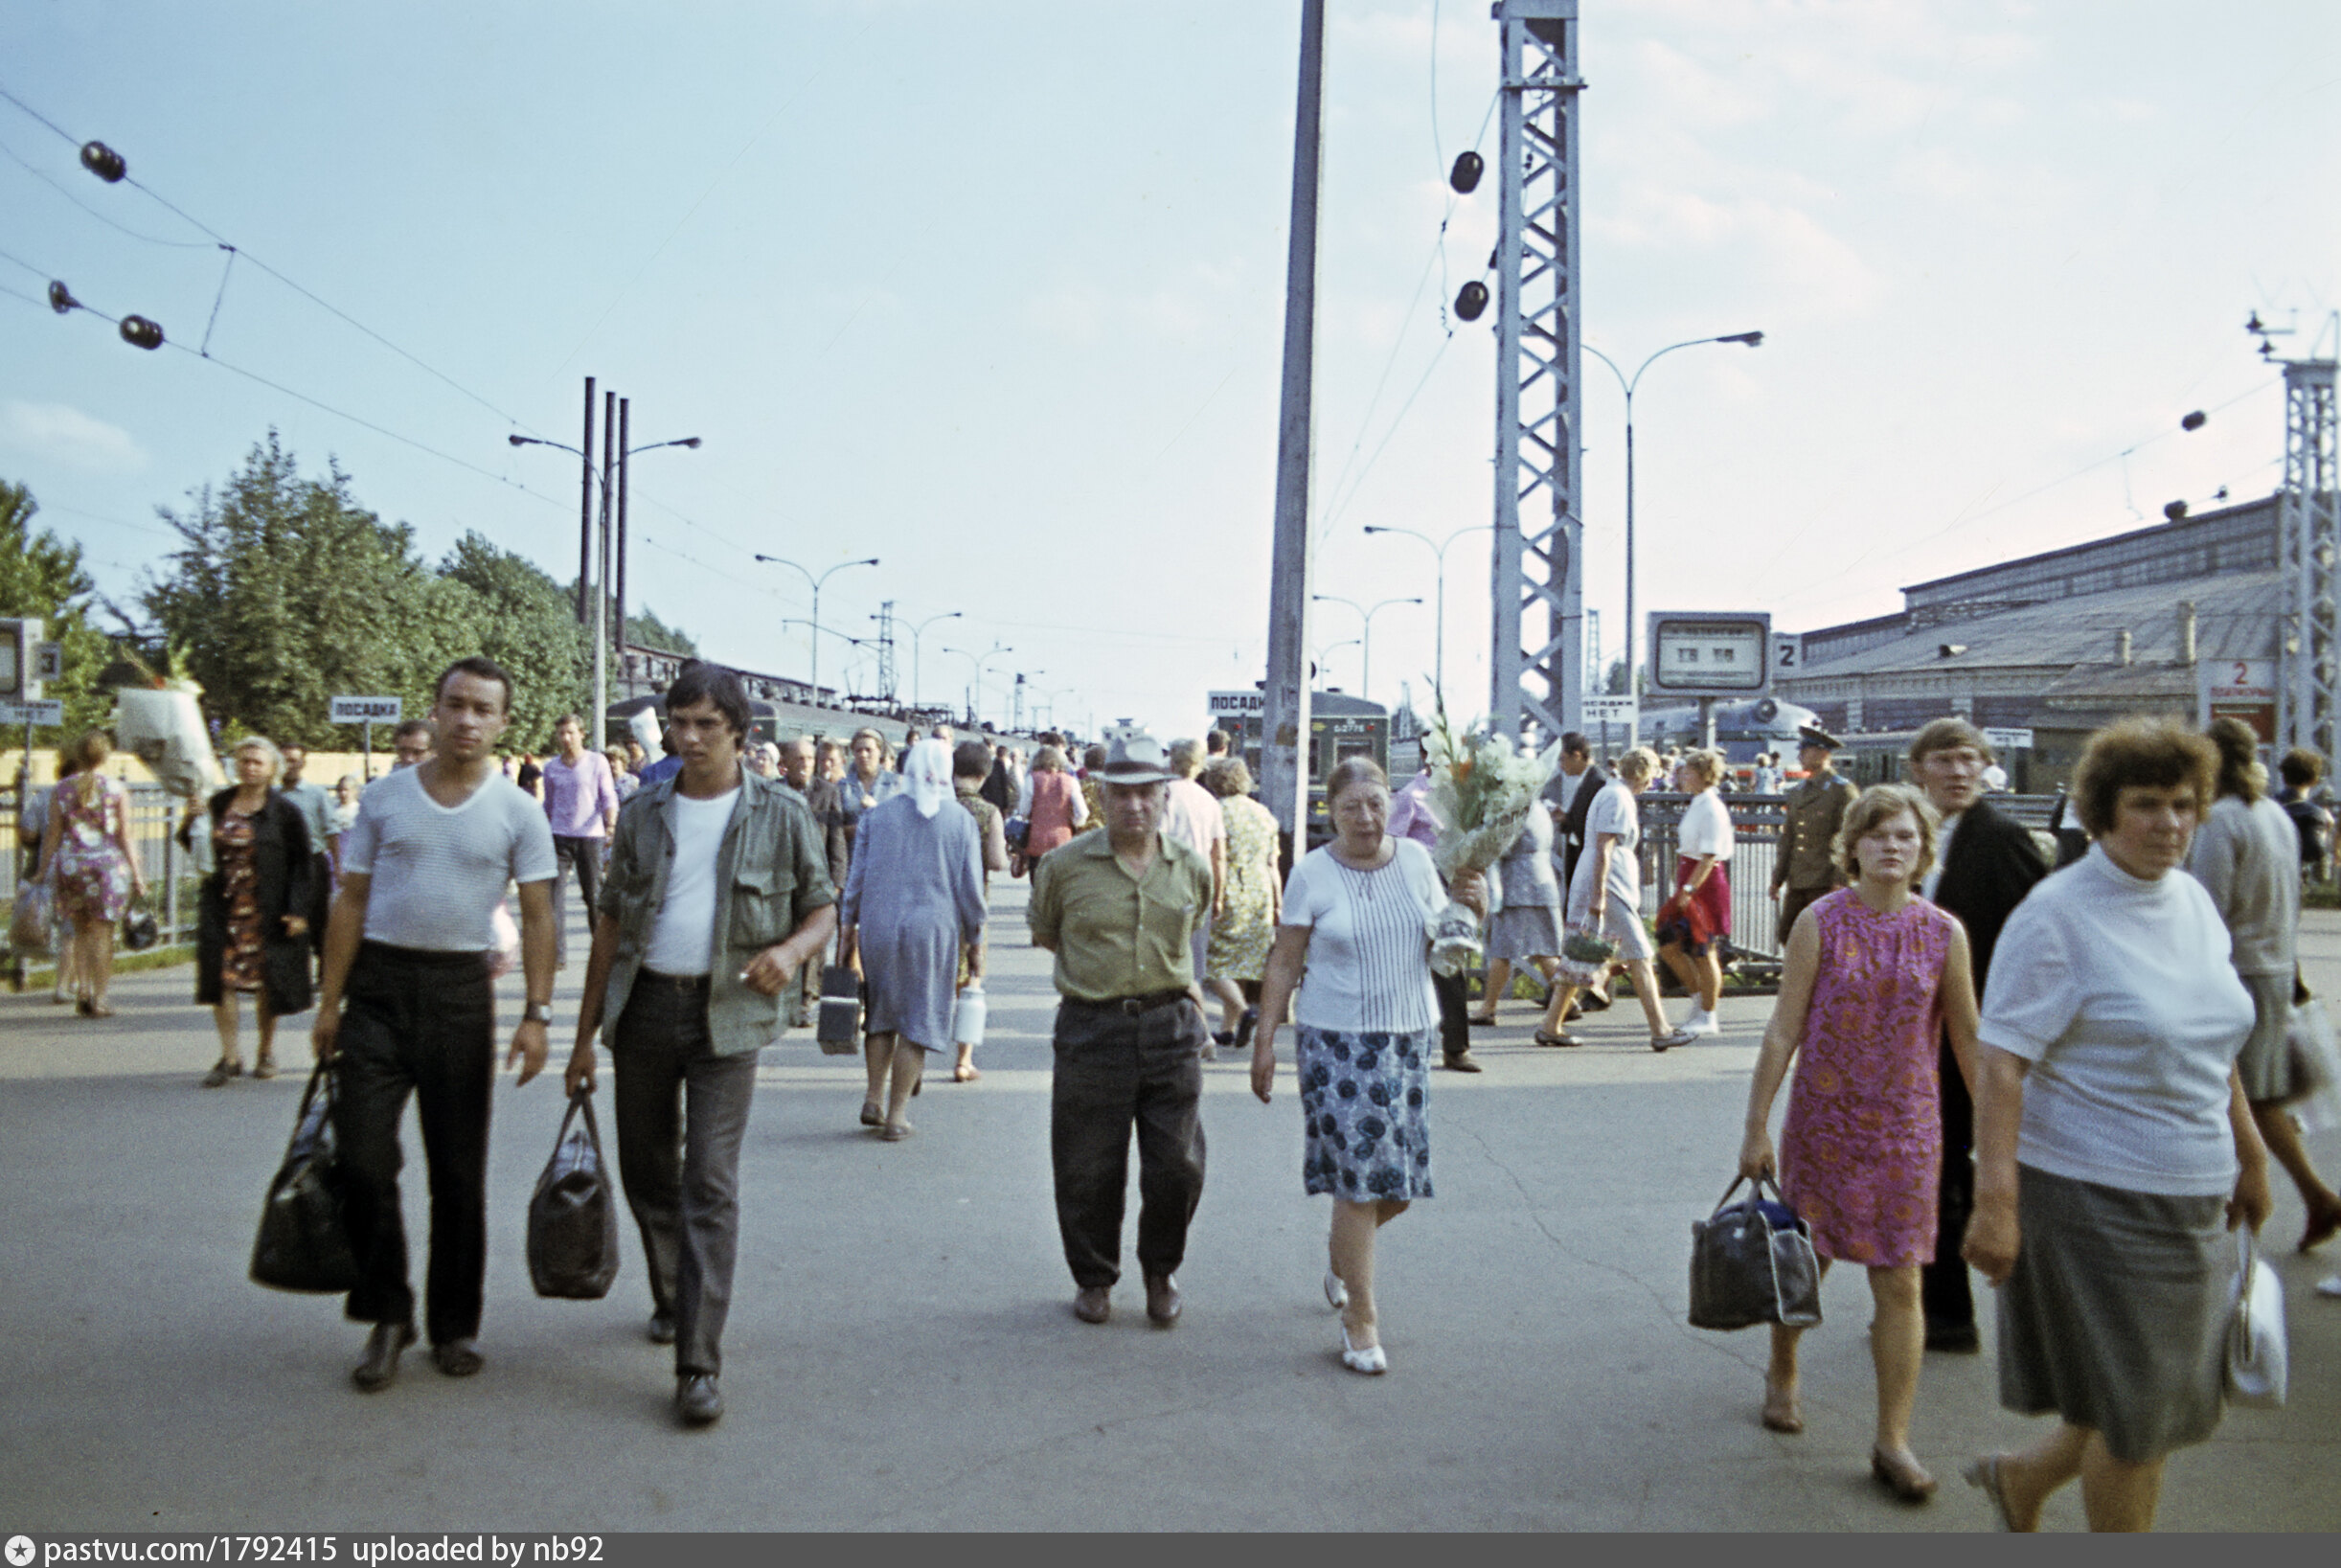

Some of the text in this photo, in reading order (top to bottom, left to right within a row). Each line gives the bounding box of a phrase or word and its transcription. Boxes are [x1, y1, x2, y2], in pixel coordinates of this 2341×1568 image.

[1780, 645, 1793, 667] 2
[2234, 662, 2249, 685] 2
[336, 703, 398, 716] ПОСАДКА
[1211, 696, 1264, 711] ПОСАДК
[1586, 709, 1619, 718] НЕТ
